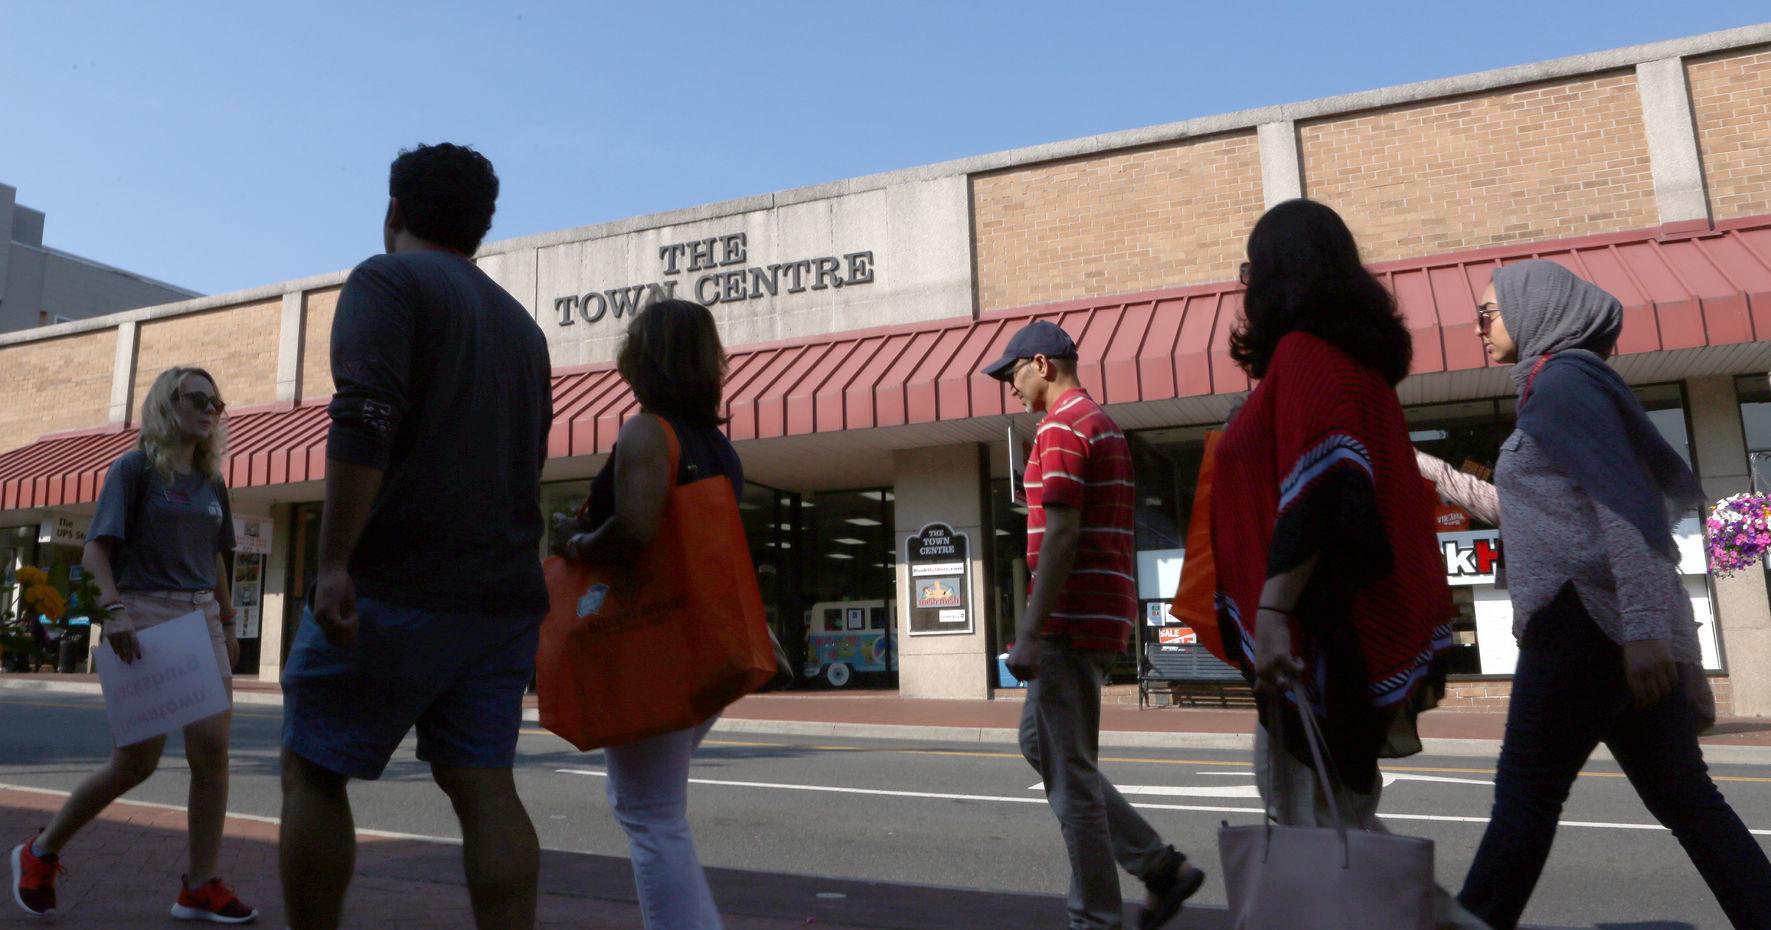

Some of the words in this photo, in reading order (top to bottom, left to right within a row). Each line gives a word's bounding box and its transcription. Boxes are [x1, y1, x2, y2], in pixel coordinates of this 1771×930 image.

[659, 232, 747, 275] THE
[695, 251, 874, 306] CENTRE
[60, 518, 73, 528] The
[57, 528, 73, 539] UPS
[923, 537, 950, 546] TOWN
[920, 545, 955, 556] CENTRE
[1160, 629, 1180, 638] SALE
